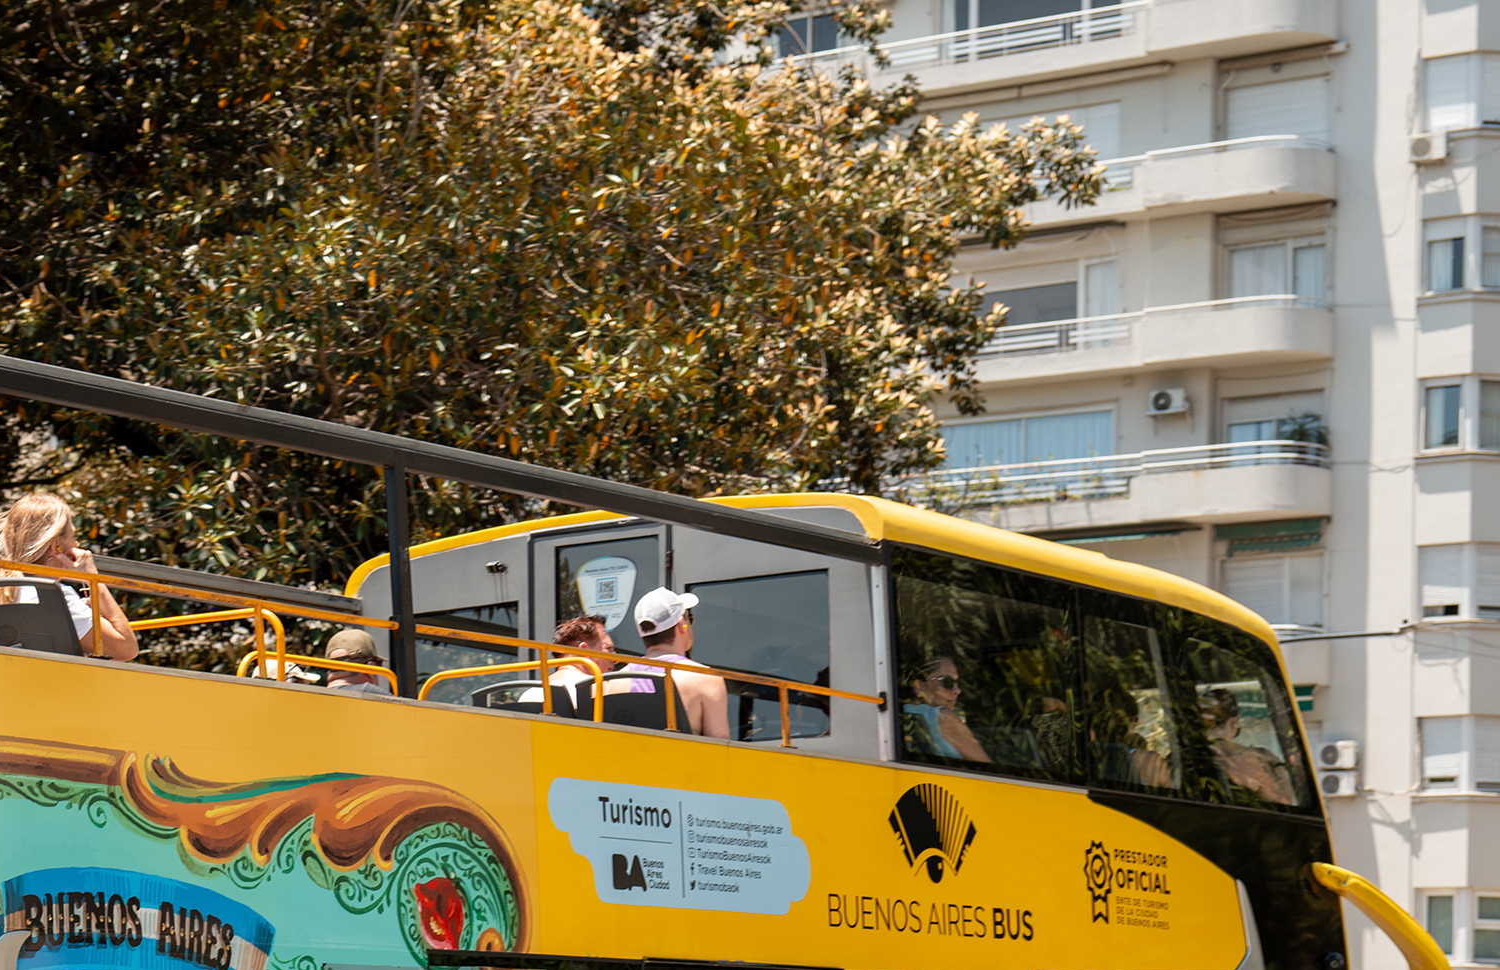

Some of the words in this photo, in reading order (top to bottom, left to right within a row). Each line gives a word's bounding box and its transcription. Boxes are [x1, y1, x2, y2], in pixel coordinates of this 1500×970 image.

[597, 796, 672, 829] Turismo
[642, 857, 665, 869] Buenos
[1113, 848, 1169, 868] PRESTADOR
[612, 853, 647, 892] BA
[647, 868, 663, 879] Aires
[697, 863, 717, 876] Travel
[719, 866, 743, 878] Buenos
[745, 868, 762, 879] Aires
[648, 879, 671, 890] Ciudad
[1115, 868, 1171, 895] OFICIAL
[22, 891, 143, 953] BUENOS
[828, 893, 923, 933] BUENOS
[927, 901, 987, 938] AIRES
[993, 907, 1034, 942] BUS
[1126, 917, 1151, 928] BUENOS
